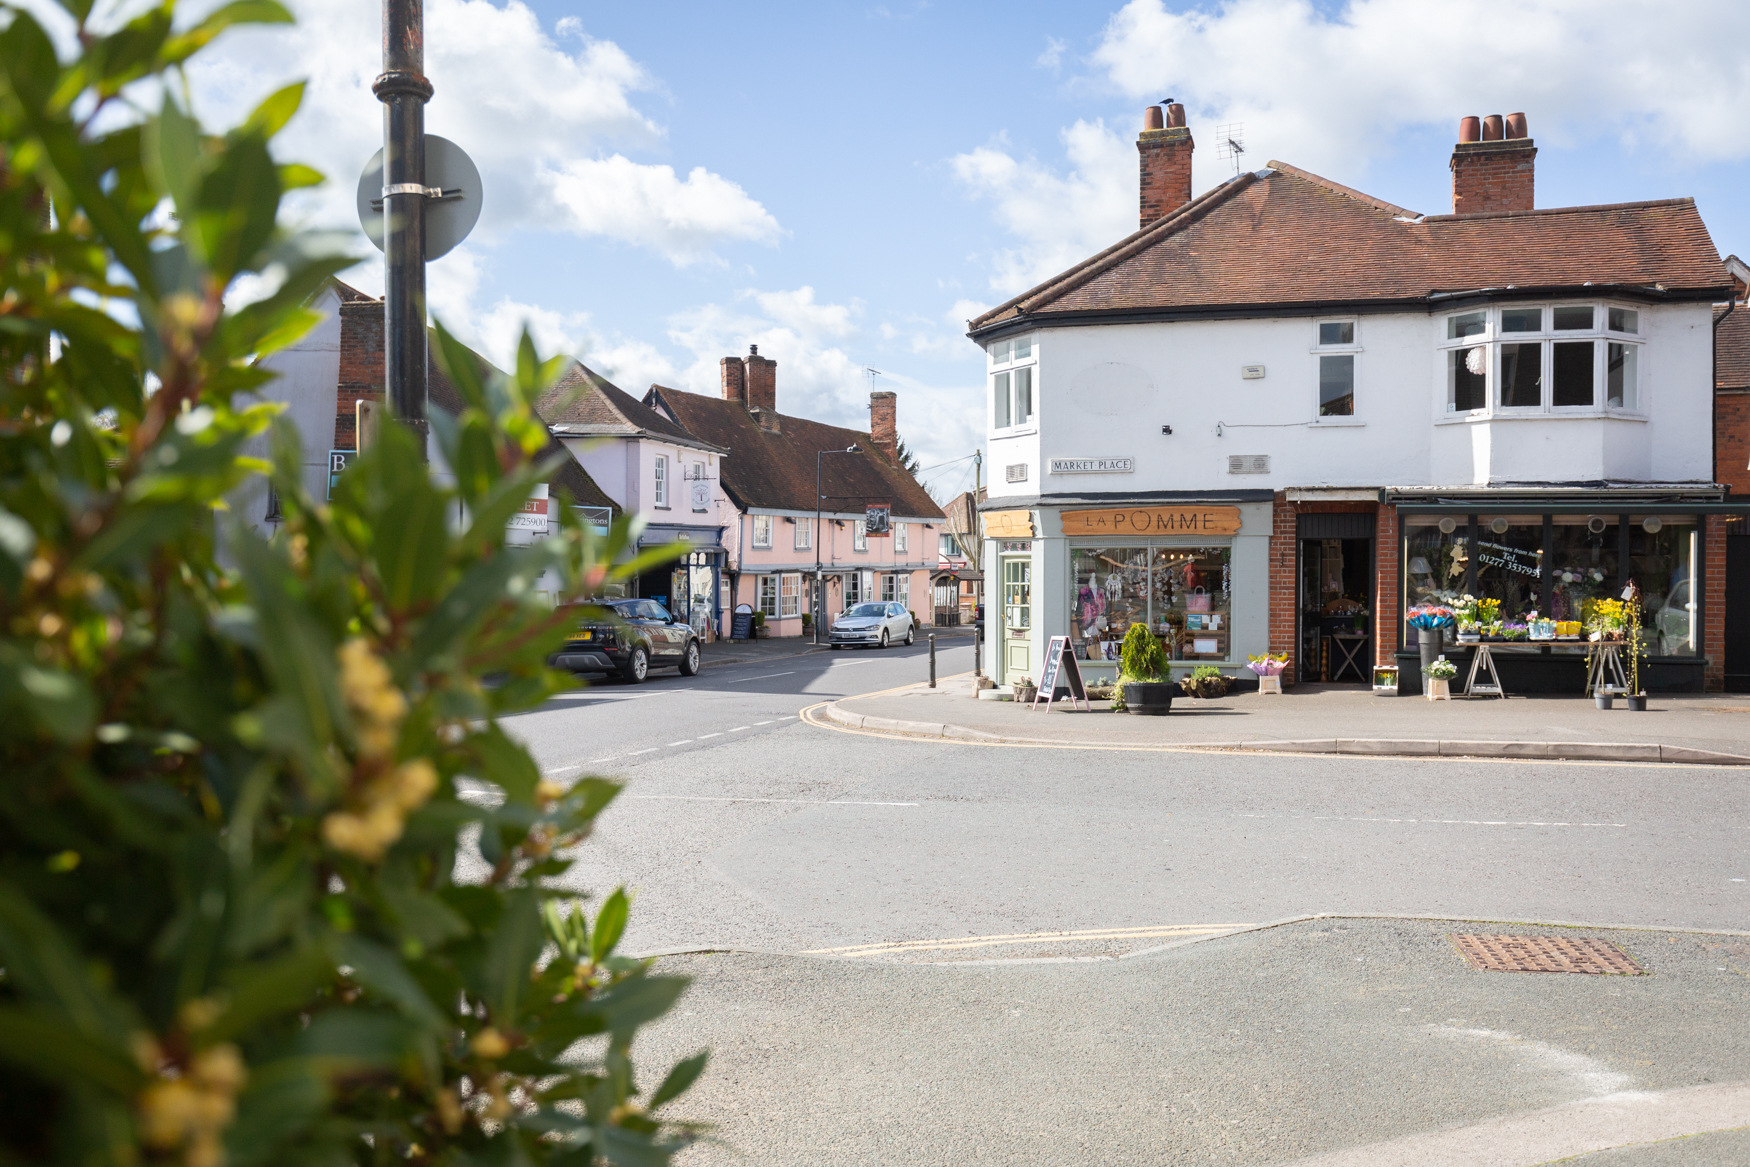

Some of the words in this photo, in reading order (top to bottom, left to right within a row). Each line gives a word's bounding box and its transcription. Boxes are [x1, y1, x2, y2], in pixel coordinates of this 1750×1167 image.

[1054, 462, 1095, 470] MARKET
[1098, 460, 1129, 469] PLACE
[516, 517, 546, 527] 725900
[1086, 516, 1107, 527] LA
[1114, 510, 1215, 531] POMME
[1479, 554, 1505, 568] 01277
[1503, 552, 1518, 562] Tel.
